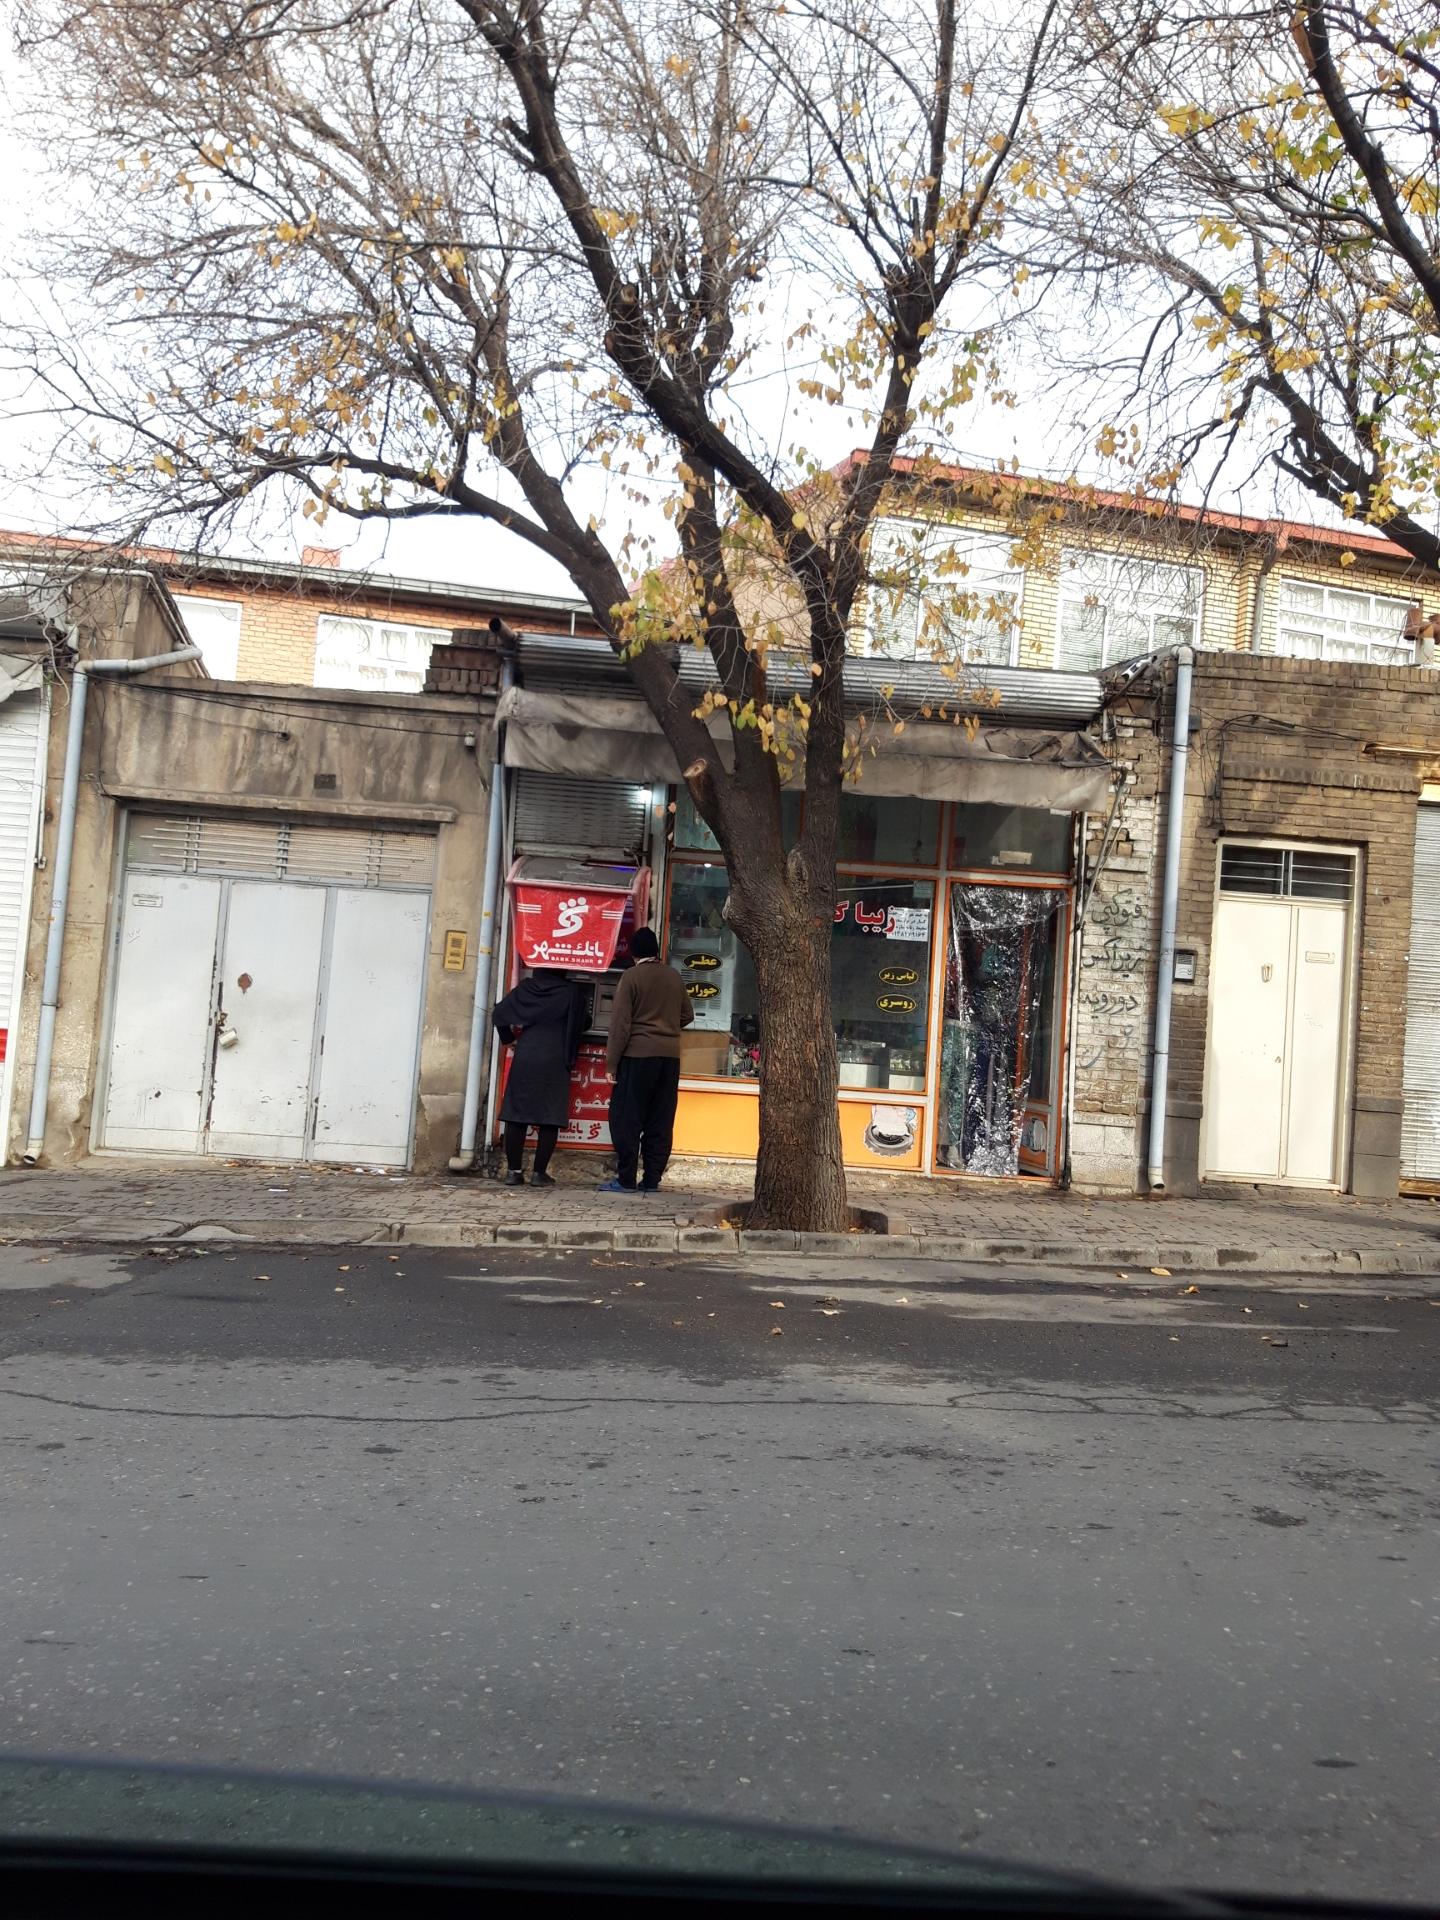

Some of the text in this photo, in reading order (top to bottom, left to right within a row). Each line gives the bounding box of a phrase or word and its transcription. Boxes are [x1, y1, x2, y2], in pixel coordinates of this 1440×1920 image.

[855, 901, 896, 933] زیبا
[688, 955, 718, 968] عطر
[879, 998, 913, 1009] روسری
